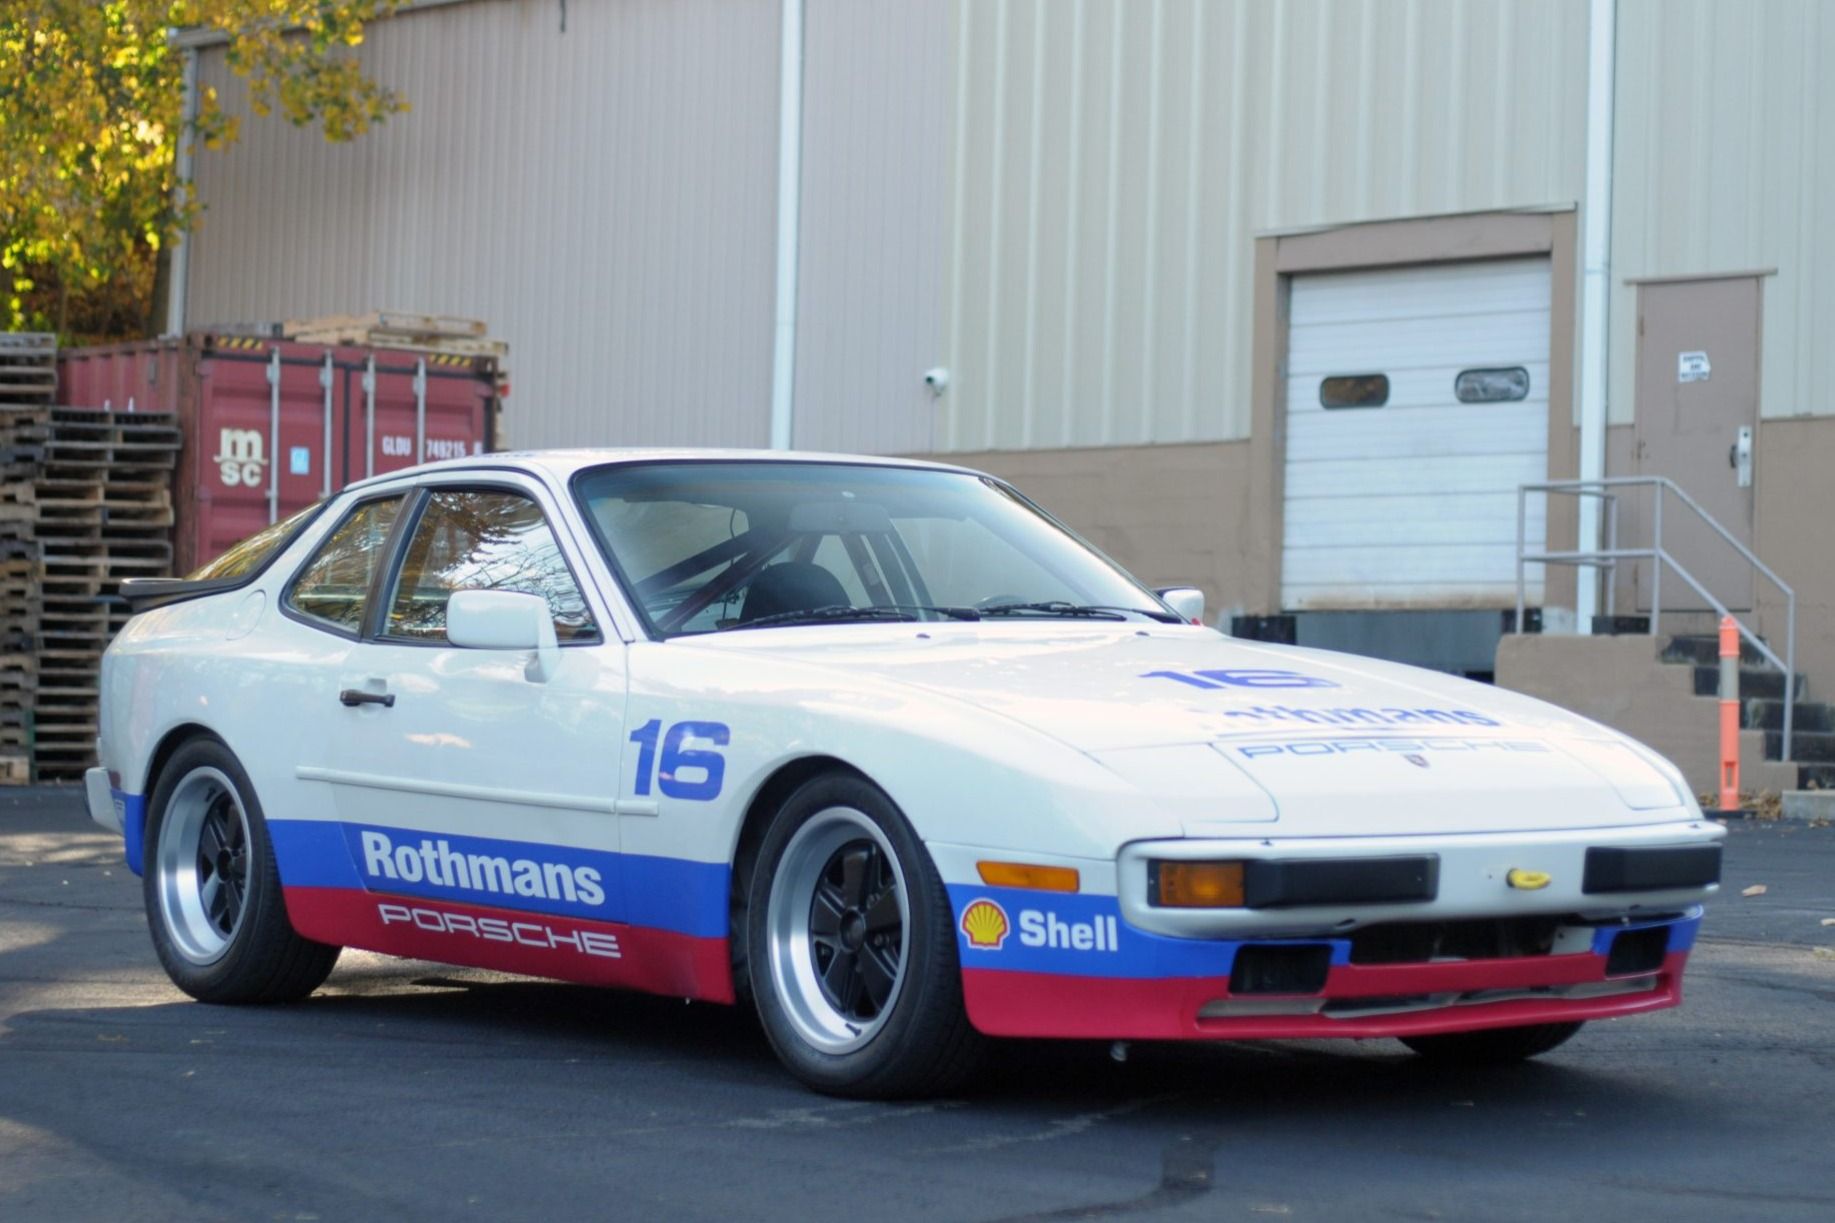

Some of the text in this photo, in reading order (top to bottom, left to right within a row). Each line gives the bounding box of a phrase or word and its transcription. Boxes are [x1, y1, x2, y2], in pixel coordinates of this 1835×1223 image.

[1137, 669, 1343, 689] 16
[1200, 705, 1501, 727] othmans
[629, 719, 731, 801] 16
[1236, 739, 1552, 759] PORSCHE
[361, 830, 606, 906] Rothmans
[377, 903, 622, 959] PORSCHE
[1018, 908, 1119, 952] Shell
